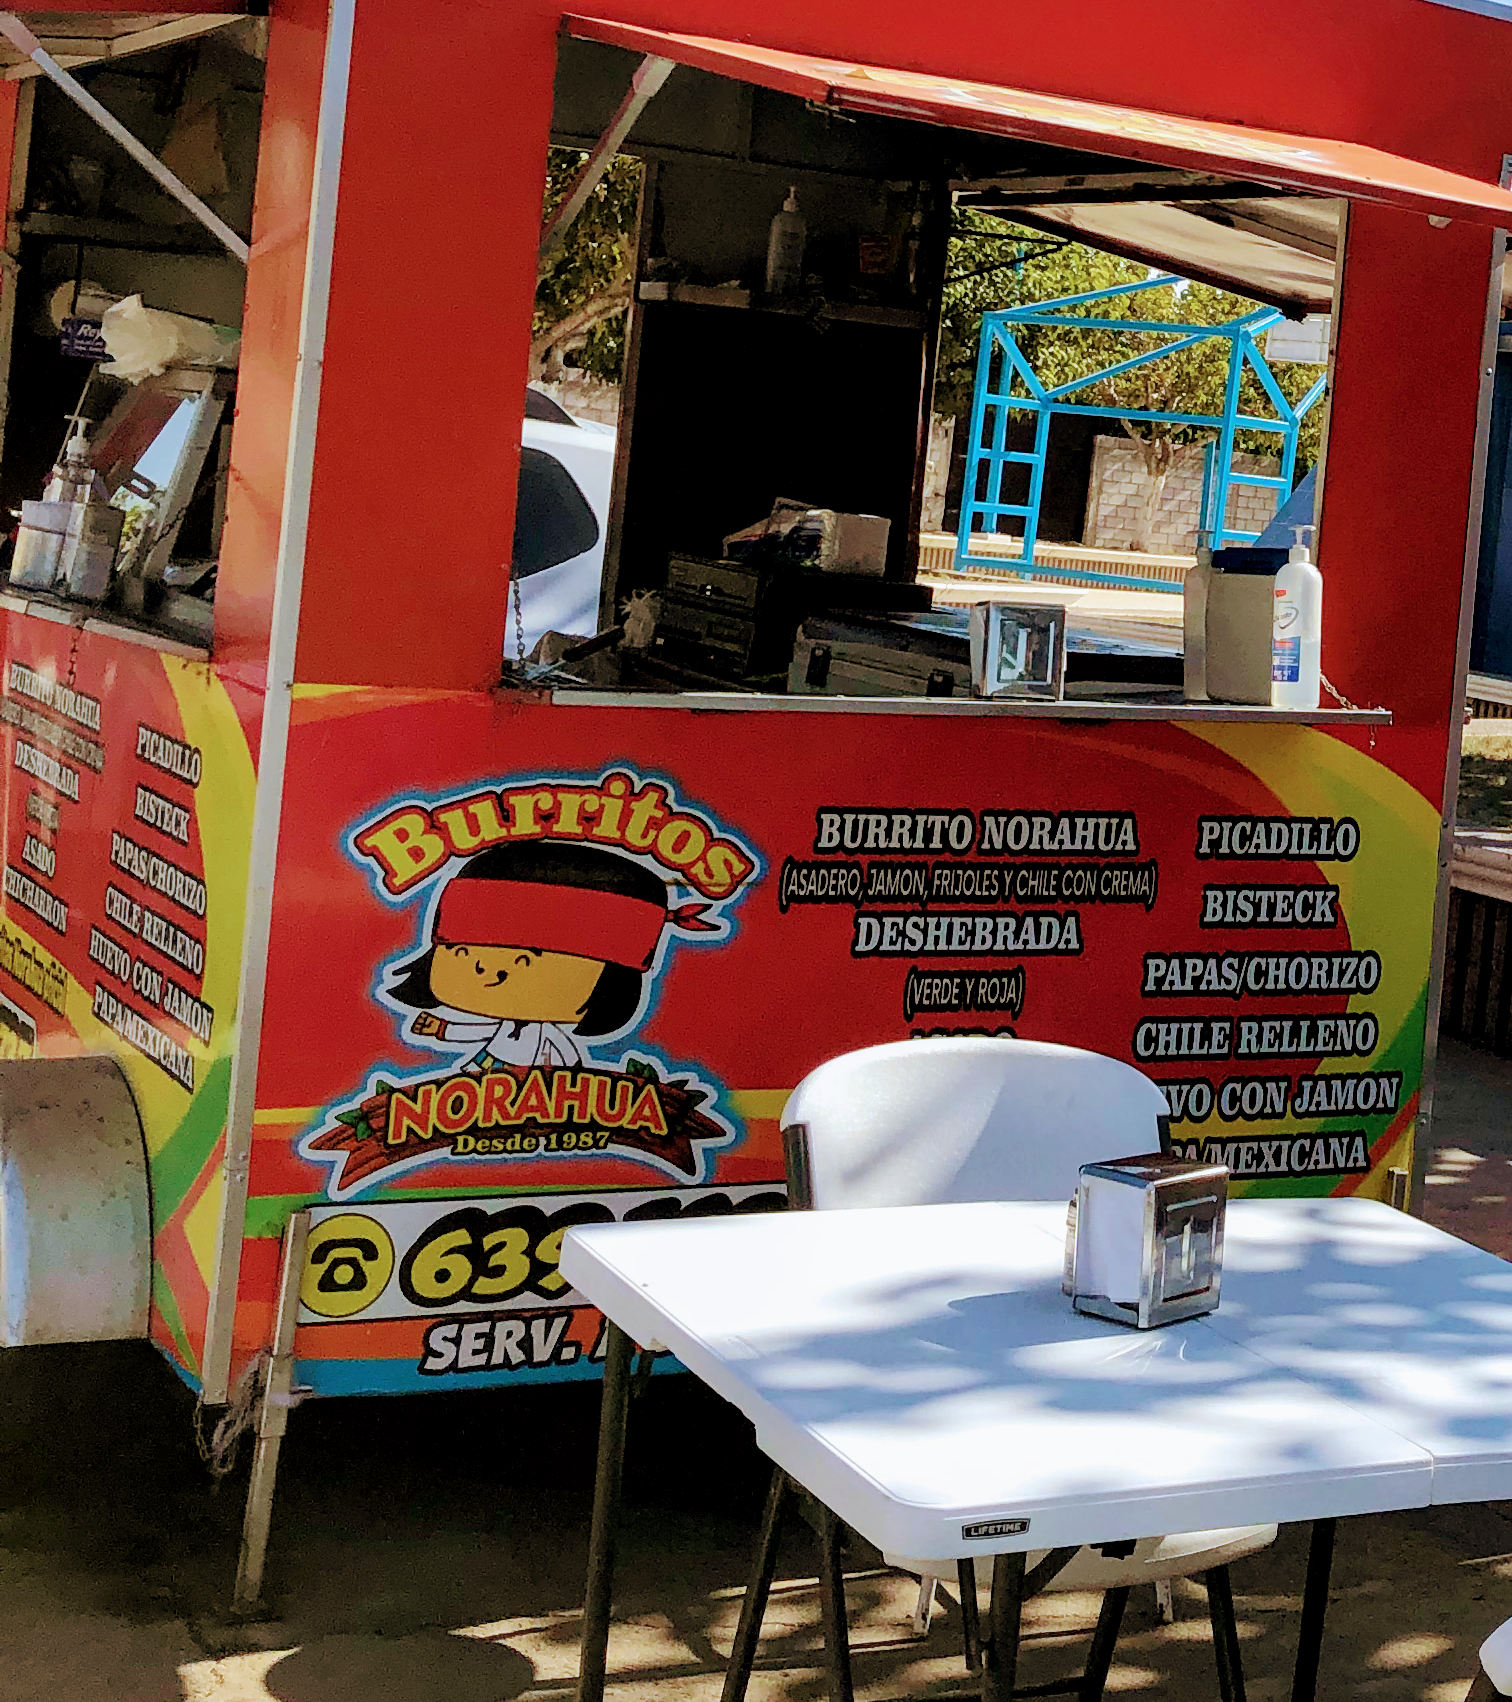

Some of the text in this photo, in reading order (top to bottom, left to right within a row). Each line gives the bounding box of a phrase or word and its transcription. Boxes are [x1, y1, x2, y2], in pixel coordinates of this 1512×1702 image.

[137, 726, 200, 783] PICADILLO
[135, 787, 190, 842] BISTECK
[362, 778, 748, 894] Burritos
[817, 813, 1137, 851] BURRITO NORAHUA
[22, 834, 56, 878] ASADO
[1198, 821, 1357, 856] PICADILLO
[111, 833, 206, 915] PAPAS/CHORIZO
[782, 863, 1156, 905] (ASADERO, JAMON, FRIJOLES Y CHILE CON CREMA)
[1203, 889, 1337, 923] BISTECK
[105, 886, 203, 975] CHILE RELLENO
[854, 916, 1080, 952] DESHEBRADA
[89, 929, 131, 982] HUEVO
[132, 960, 163, 1004] CON
[164, 981, 213, 1042] JAMON
[906, 972, 1023, 1015] (VERDE Y ROJA)
[1144, 955, 1379, 992] PAPAS/CHORIZO
[94, 984, 194, 1089] PAPA/MEXICANA
[1136, 1018, 1376, 1057] CHILE RELLENO
[387, 1069, 669, 1145] NORAHUA
[1220, 1081, 1288, 1116] CON
[1294, 1077, 1400, 1113] JAMON
[454, 1131, 611, 1154] Desde 1987
[423, 1316, 576, 1370] SERV.
[970, 1522, 1022, 1536] LIFETIME
